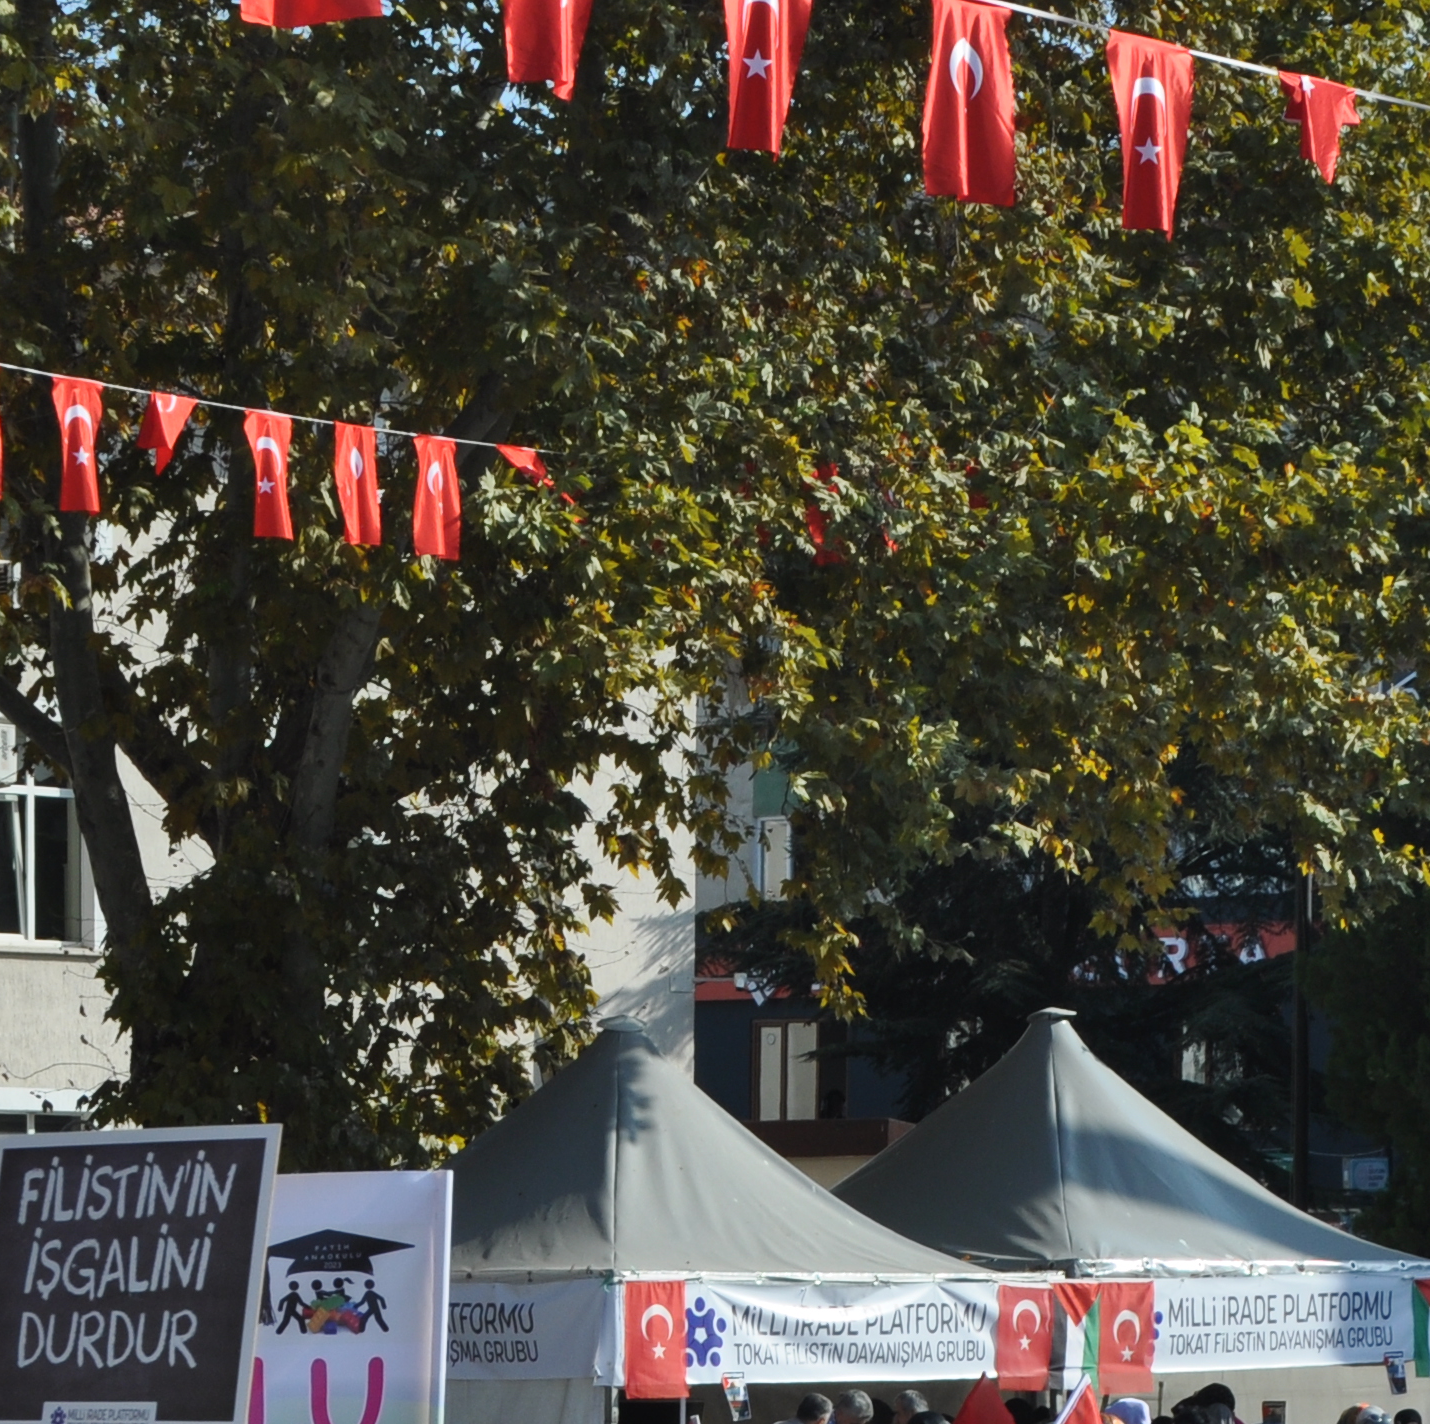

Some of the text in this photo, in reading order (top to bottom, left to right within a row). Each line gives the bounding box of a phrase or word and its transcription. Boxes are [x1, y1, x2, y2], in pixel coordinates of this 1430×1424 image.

[18, 1149, 237, 1225] FİLİSTİN'İN
[24, 1222, 215, 1301] İŞGALİNİ
[447, 1302, 535, 1334] TFORMU
[864, 1302, 987, 1336] PLATFORMU
[1283, 1290, 1393, 1324] PLATFORMU
[18, 1309, 197, 1369] DURDUR
[483, 1339, 539, 1363] GRUBU
[733, 1343, 780, 1366] TOKAT
[847, 1340, 933, 1368] DAYANIŞMA
[936, 1339, 986, 1362] GRUBU
[1169, 1333, 1211, 1355] TOKAT
[1269, 1328, 1345, 1353] DAYANIŞMA
[1347, 1326, 1393, 1348] GRUBU
